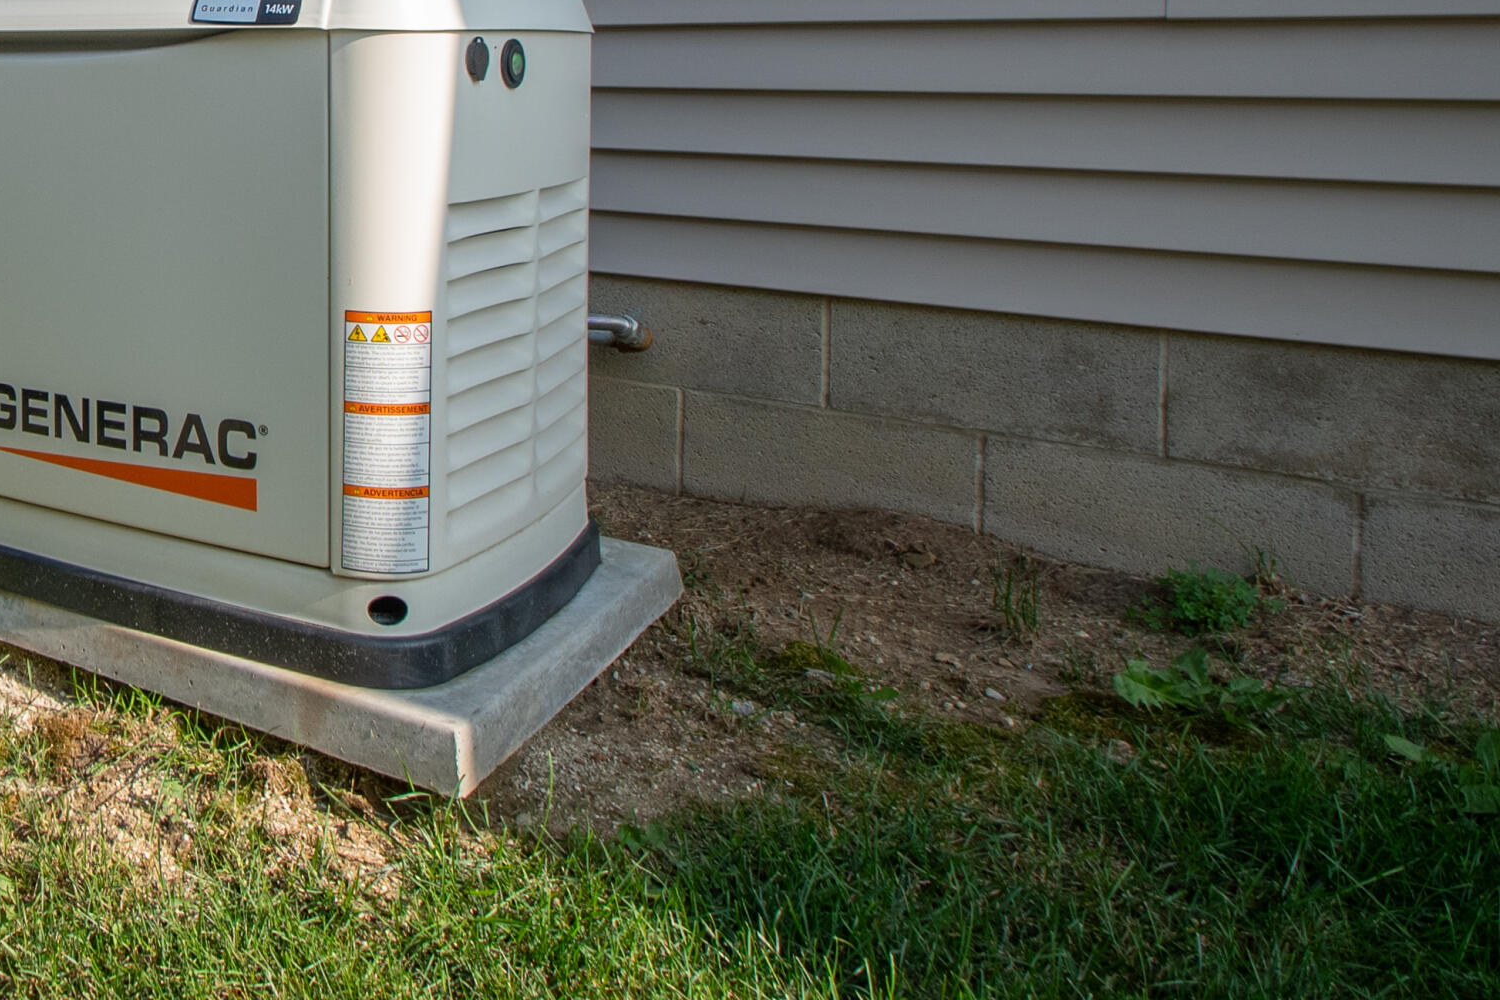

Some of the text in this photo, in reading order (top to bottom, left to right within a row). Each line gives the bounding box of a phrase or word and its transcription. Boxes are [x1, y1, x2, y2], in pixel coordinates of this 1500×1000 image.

[201, 3, 294, 14] Guardian 14kW
[377, 314, 417, 322] WARNING
[359, 404, 428, 414] AVERTISSEMENT
[363, 488, 424, 497] ADVERTENCIA
